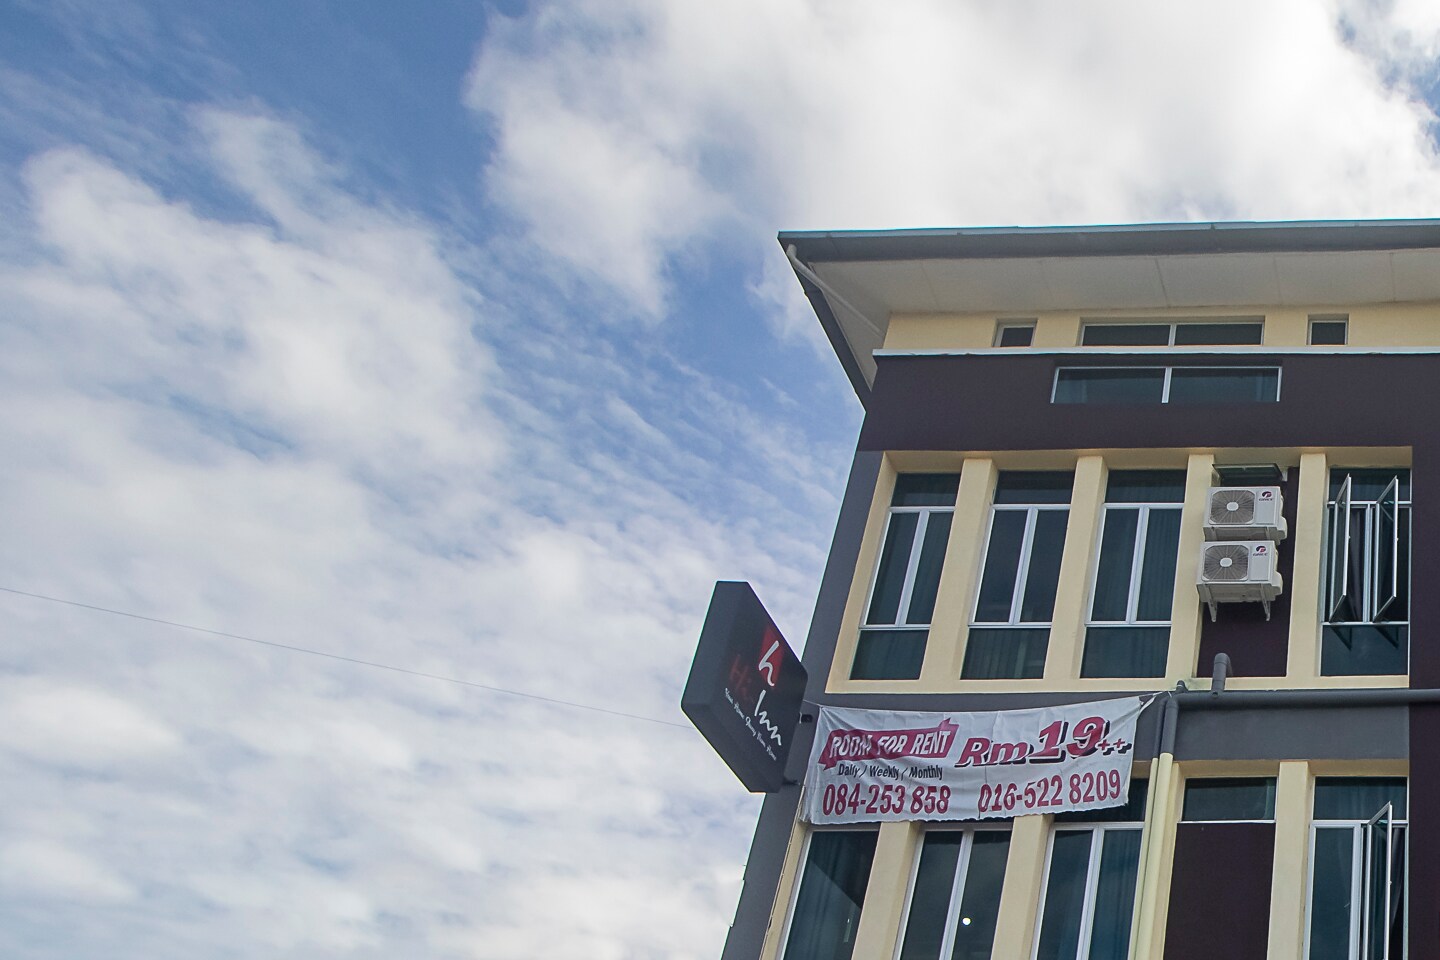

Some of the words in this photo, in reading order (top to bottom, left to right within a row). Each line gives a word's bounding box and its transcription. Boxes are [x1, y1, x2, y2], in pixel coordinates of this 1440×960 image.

[829, 734, 873, 758] ROOM
[877, 735, 908, 755] FOR
[910, 730, 951, 755] RENT
[838, 763, 862, 777] Daily
[869, 765, 899, 781] Weekly
[909, 765, 944, 781] Monthly
[822, 782, 906, 816] 084-253
[910, 784, 952, 815] 858
[978, 775, 1063, 813] 016-522
[1068, 769, 1121, 804] 8209
